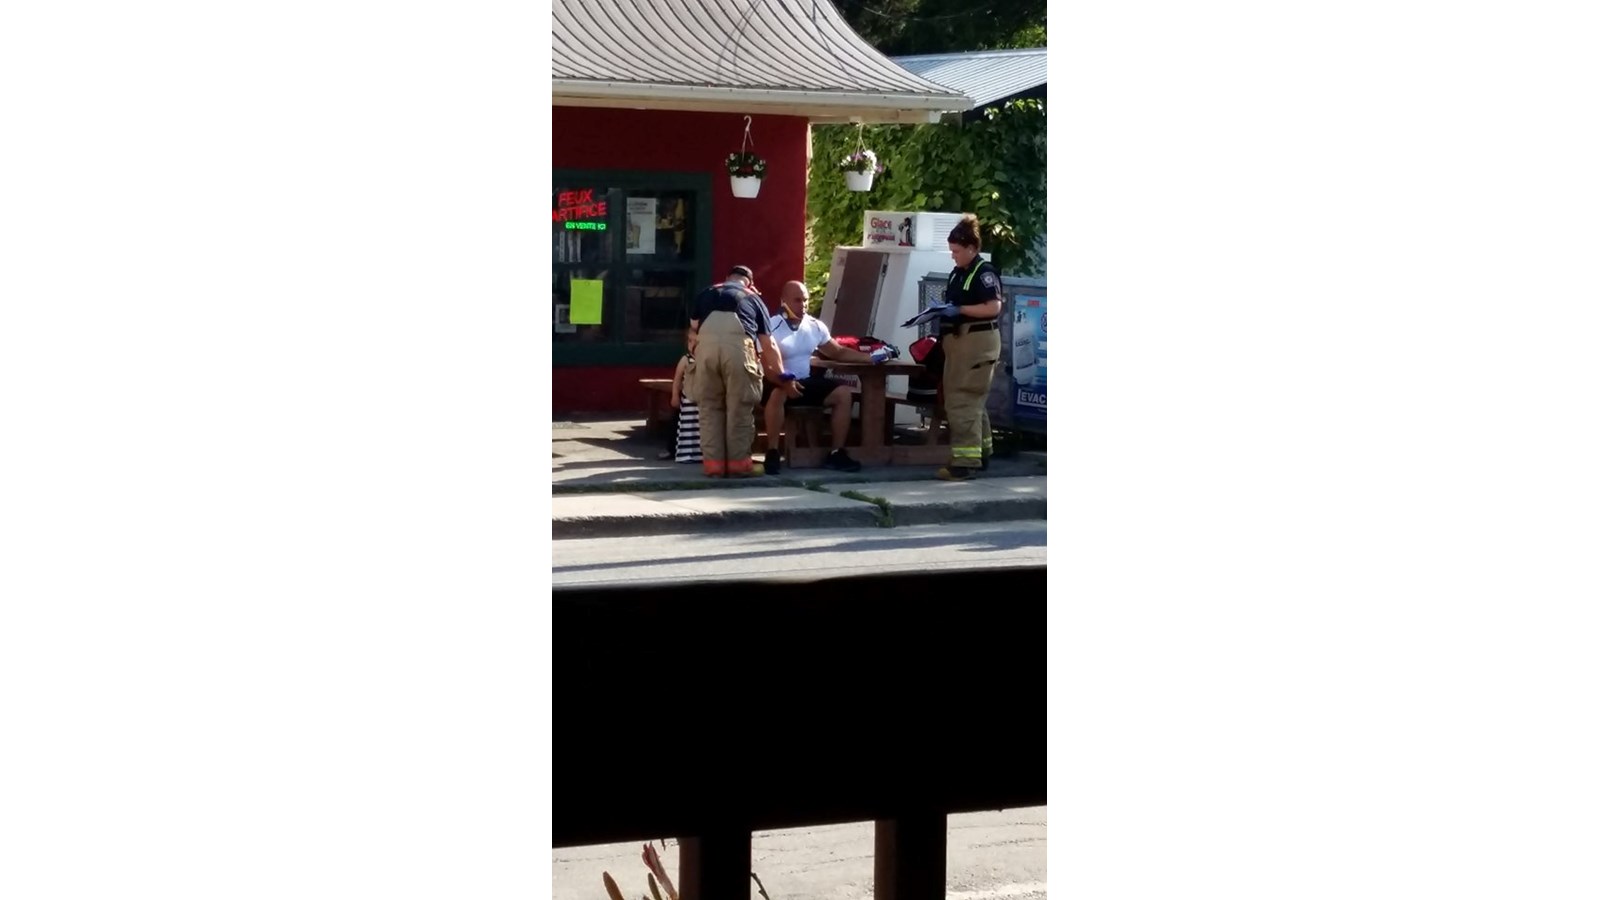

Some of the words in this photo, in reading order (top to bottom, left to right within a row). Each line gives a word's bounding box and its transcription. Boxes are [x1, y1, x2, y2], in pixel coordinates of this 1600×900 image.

[558, 189, 593, 207] FEUX
[576, 222, 596, 230] VENTE
[1021, 391, 1047, 404] EVAC
